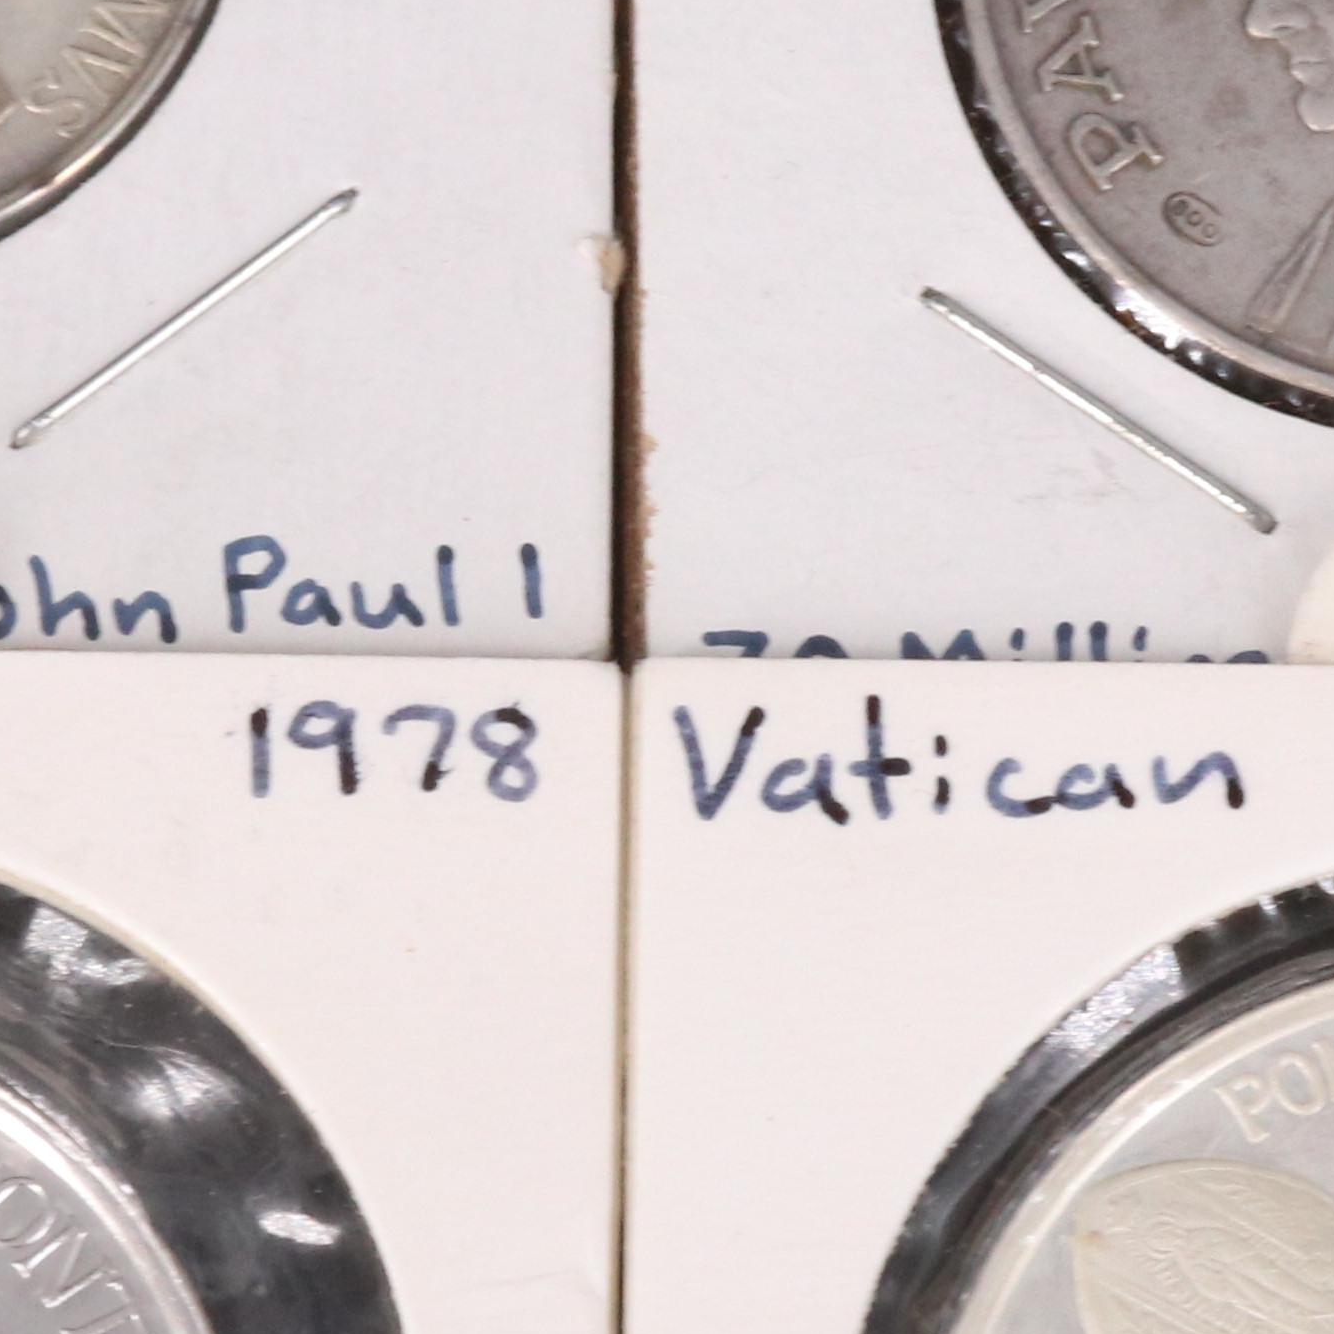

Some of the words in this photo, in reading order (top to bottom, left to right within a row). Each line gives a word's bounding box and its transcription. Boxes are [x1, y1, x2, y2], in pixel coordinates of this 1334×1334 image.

[223, 535, 460, 634] Paul
[249, 701, 536, 802] 1978
[674, 695, 1245, 826] Vatican
